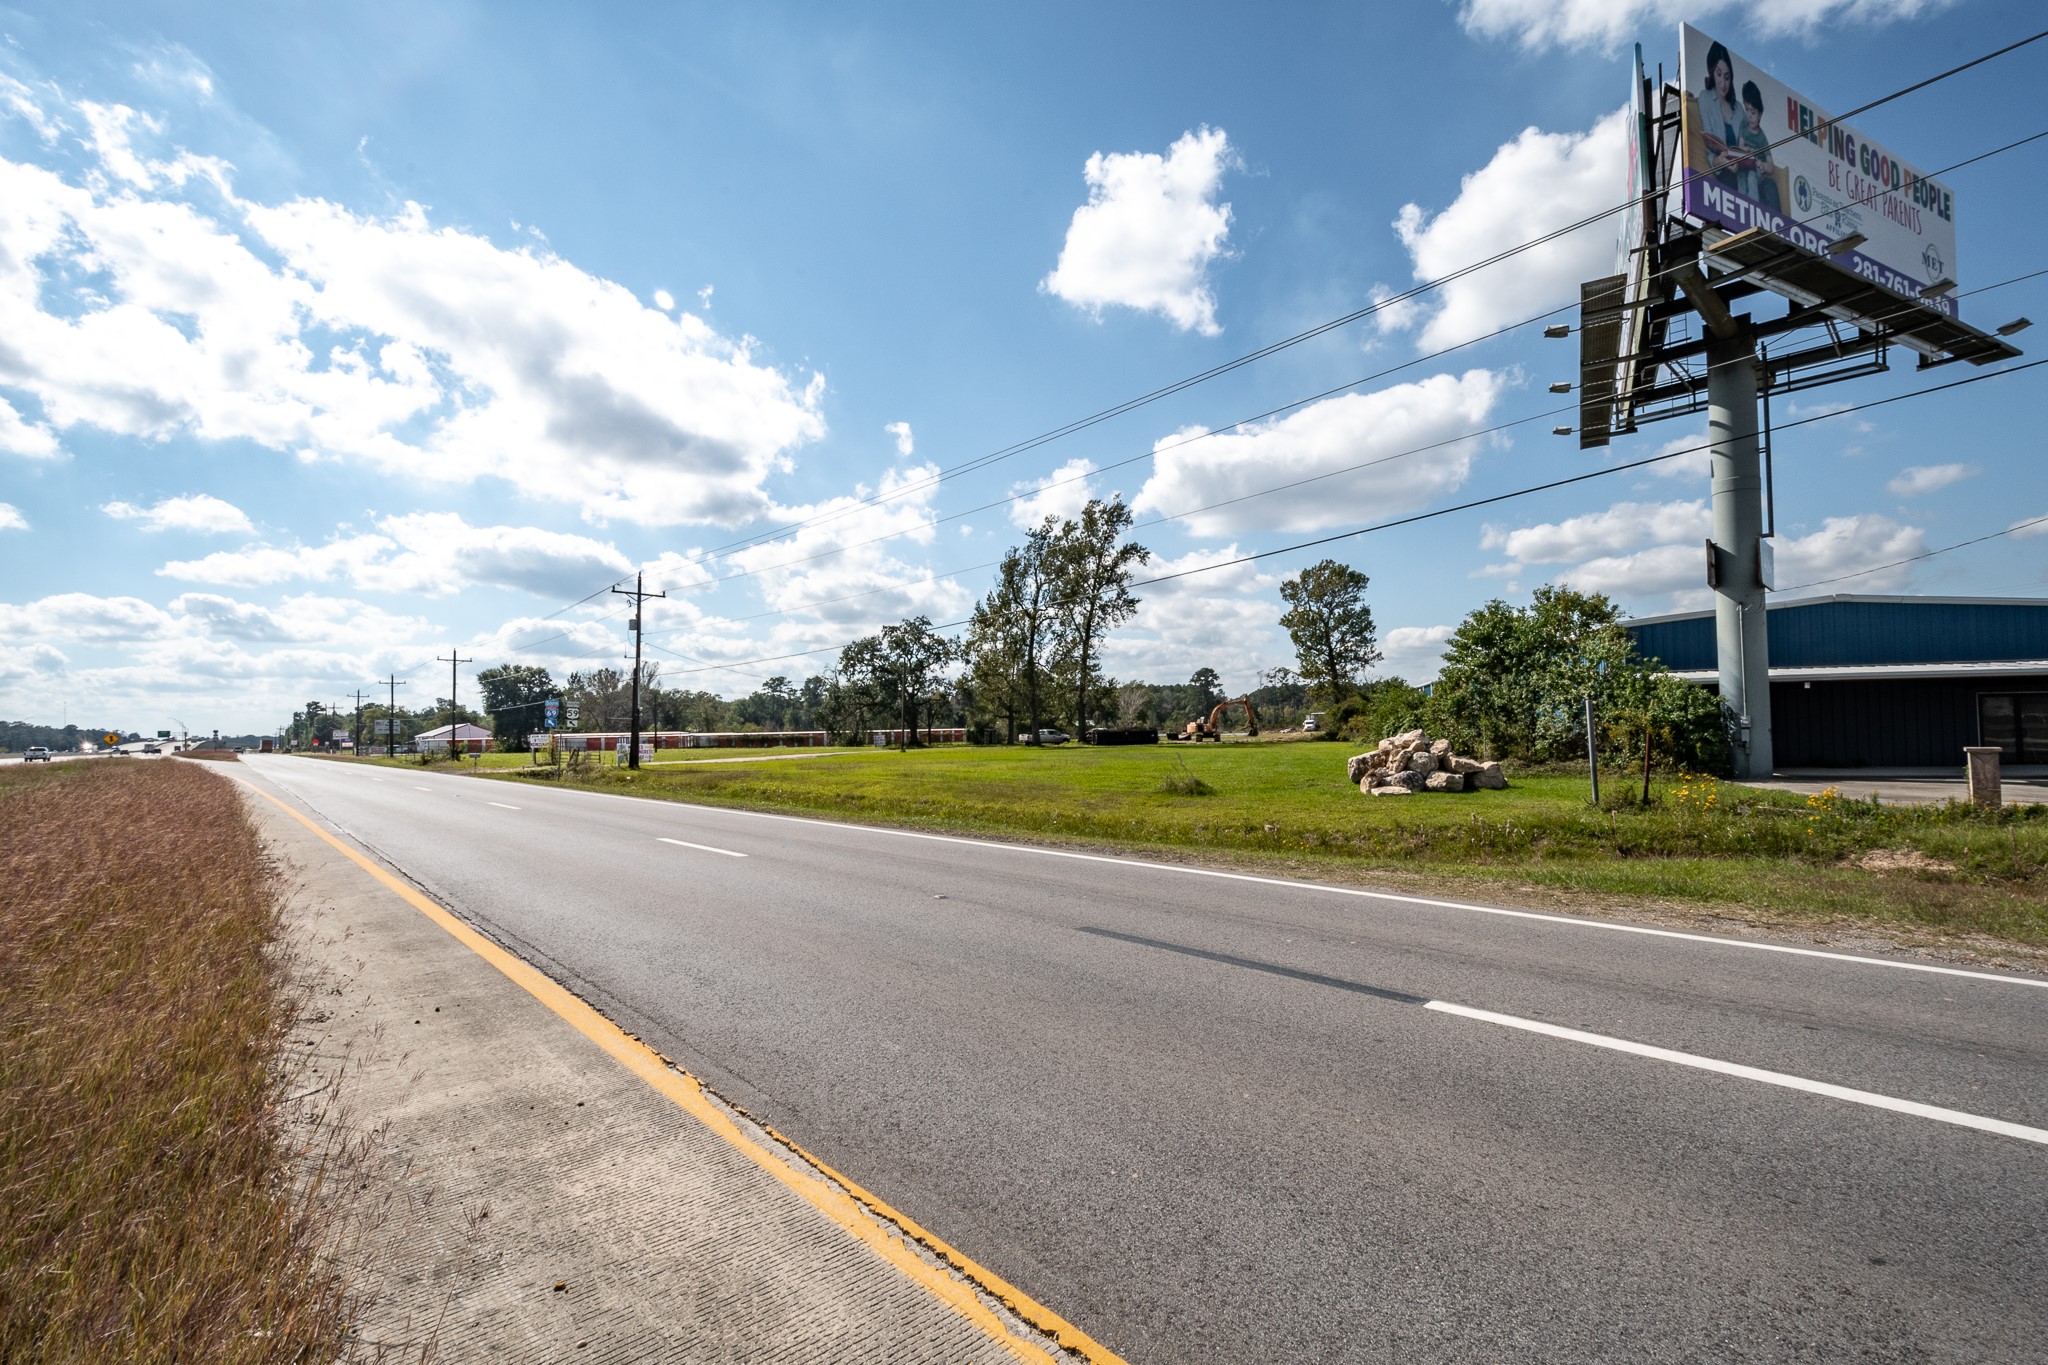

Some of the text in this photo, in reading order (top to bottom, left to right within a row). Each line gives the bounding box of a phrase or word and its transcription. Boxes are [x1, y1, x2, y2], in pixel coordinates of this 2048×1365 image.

[1787, 96, 1951, 222] HELPING GOOD PEOPLE
[1828, 159, 1922, 235] BE GREAT PARENTS
[1922, 251, 1944, 274] MET
[567, 709, 579, 717] 59
